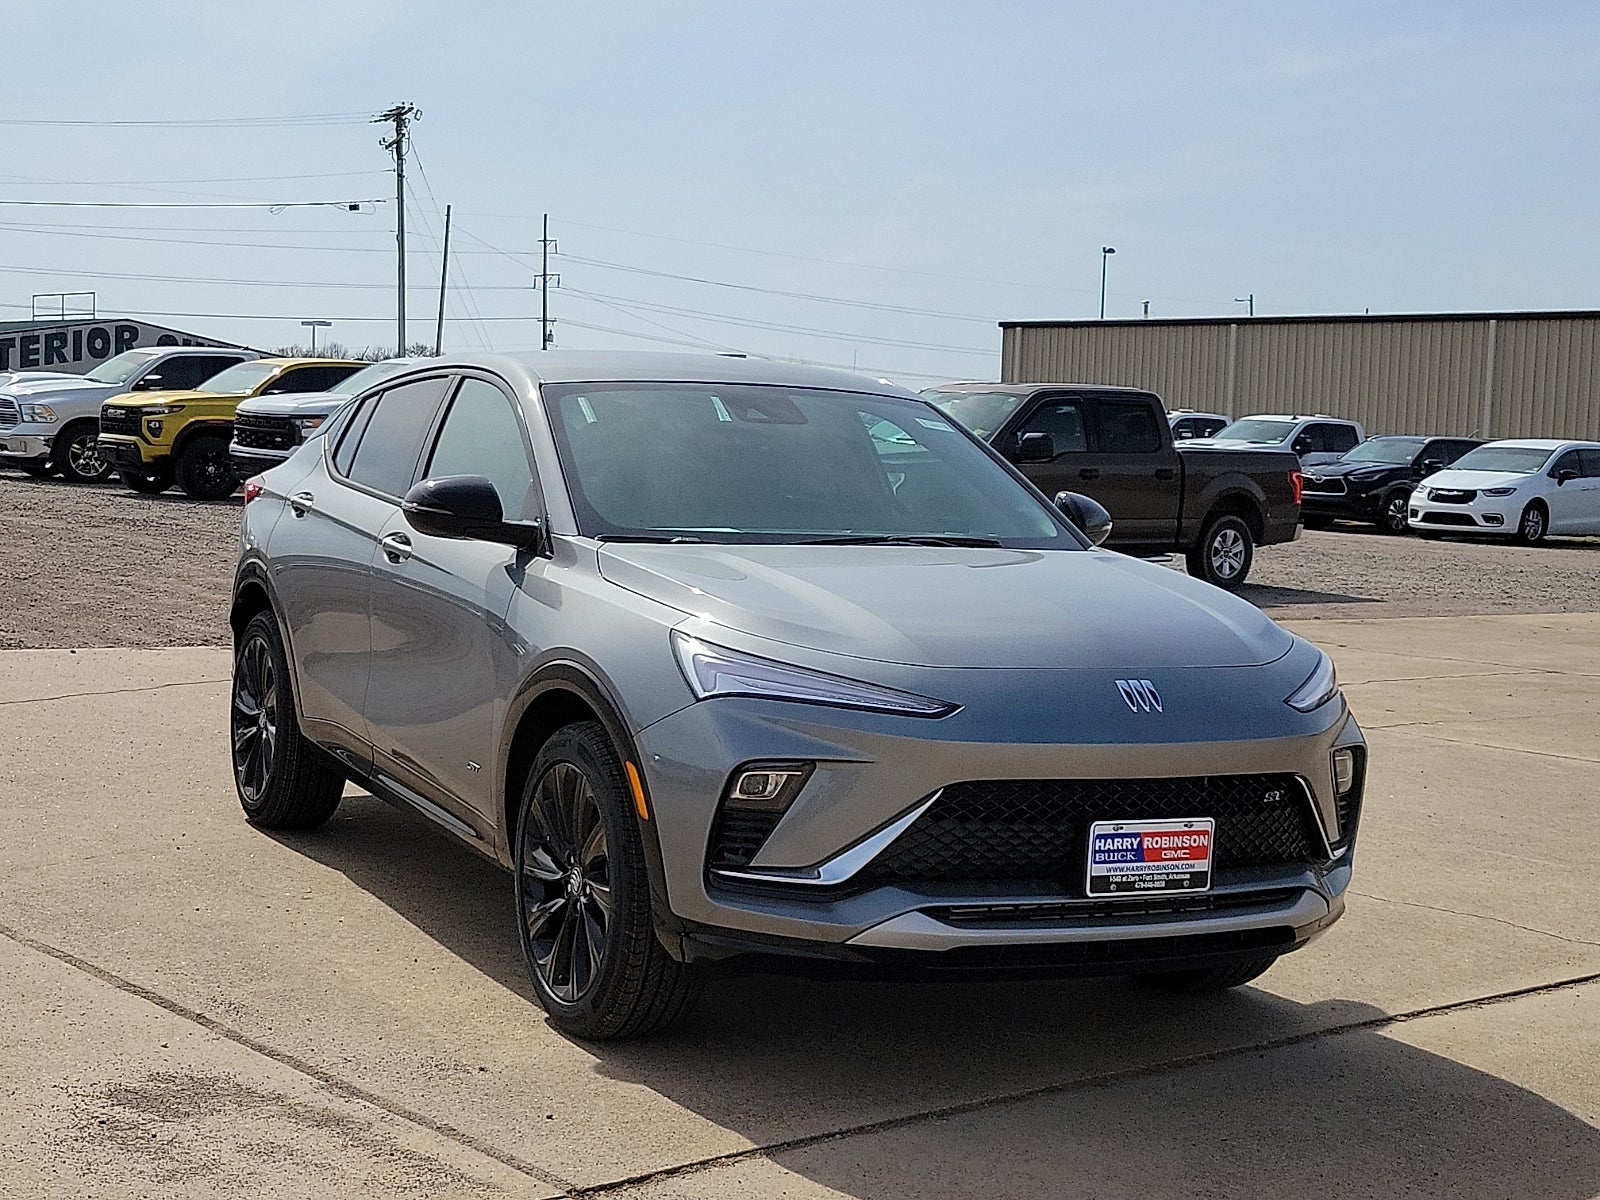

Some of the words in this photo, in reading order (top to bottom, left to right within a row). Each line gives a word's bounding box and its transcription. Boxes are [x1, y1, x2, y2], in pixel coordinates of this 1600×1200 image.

[0, 324, 139, 370] TERIOR
[1095, 837, 1140, 850] HARRY
[1144, 835, 1208, 849] ROBINSON
[1095, 852, 1137, 861] BUICK
[1161, 849, 1190, 859] GMC
[1106, 863, 1195, 873] WWW.HARRYROBINSON.COM
